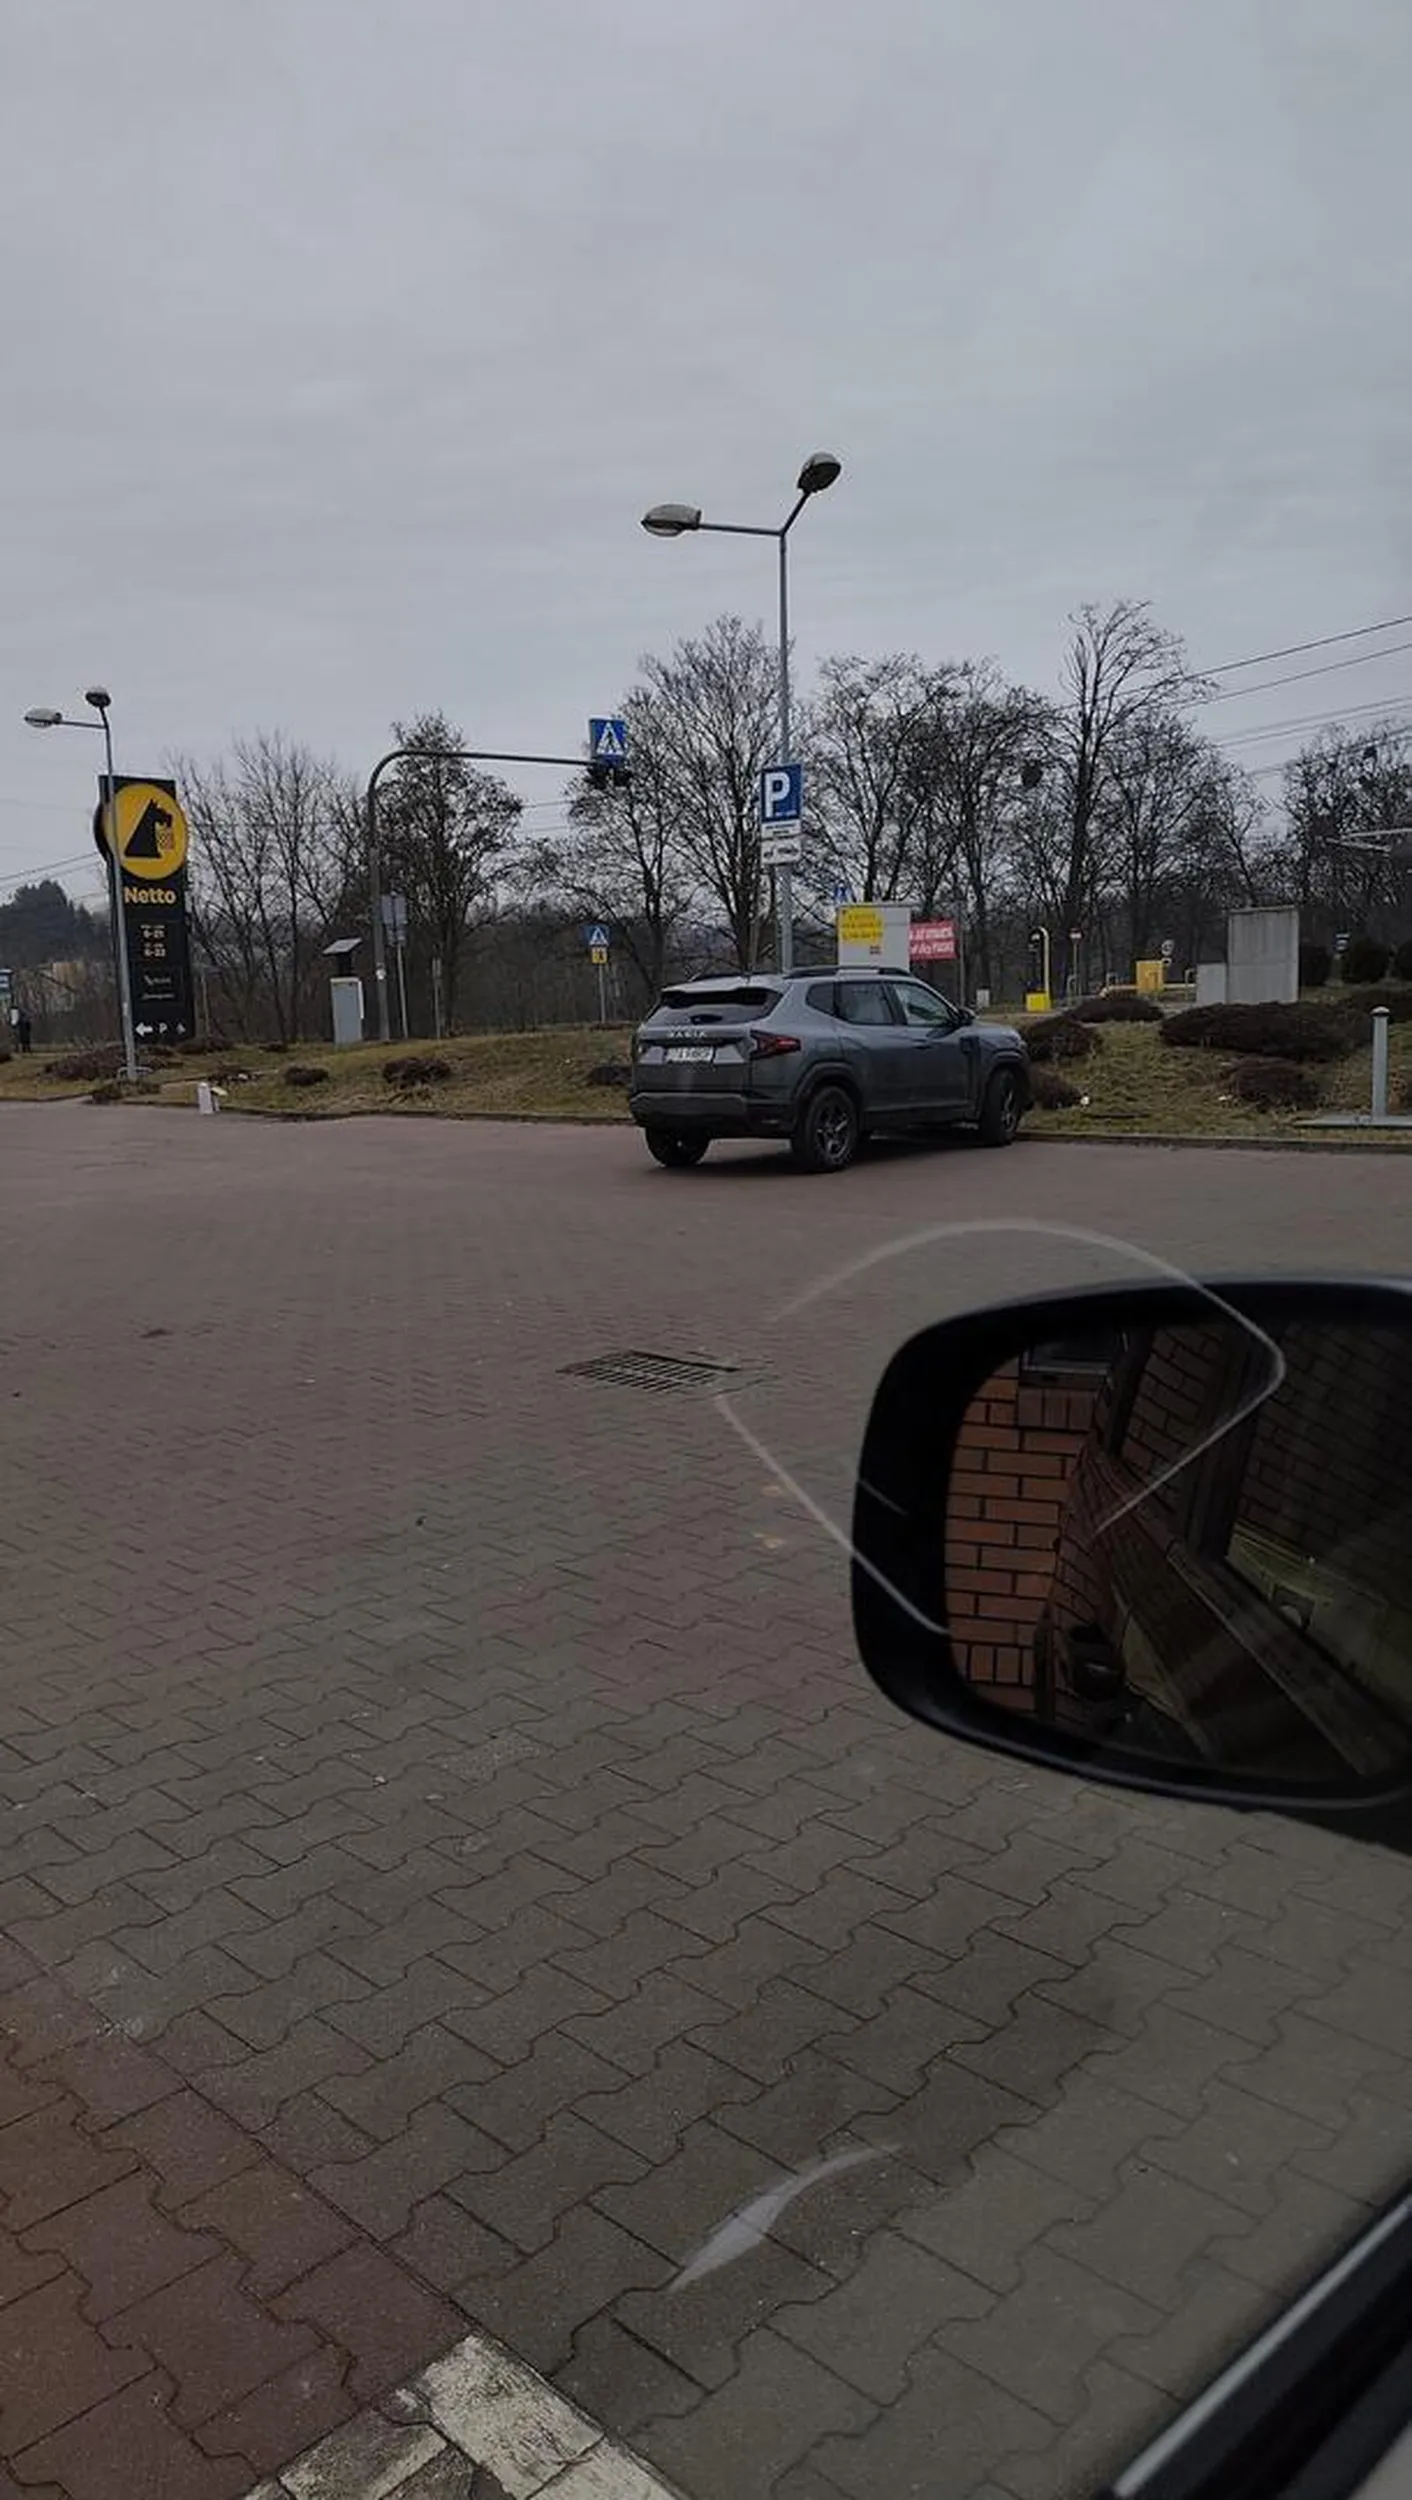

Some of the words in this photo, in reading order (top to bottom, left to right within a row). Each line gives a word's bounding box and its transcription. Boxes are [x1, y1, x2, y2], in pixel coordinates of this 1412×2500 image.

[764, 772, 790, 818] P
[124, 886, 176, 905] Netto
[159, 1022, 168, 1034] P
